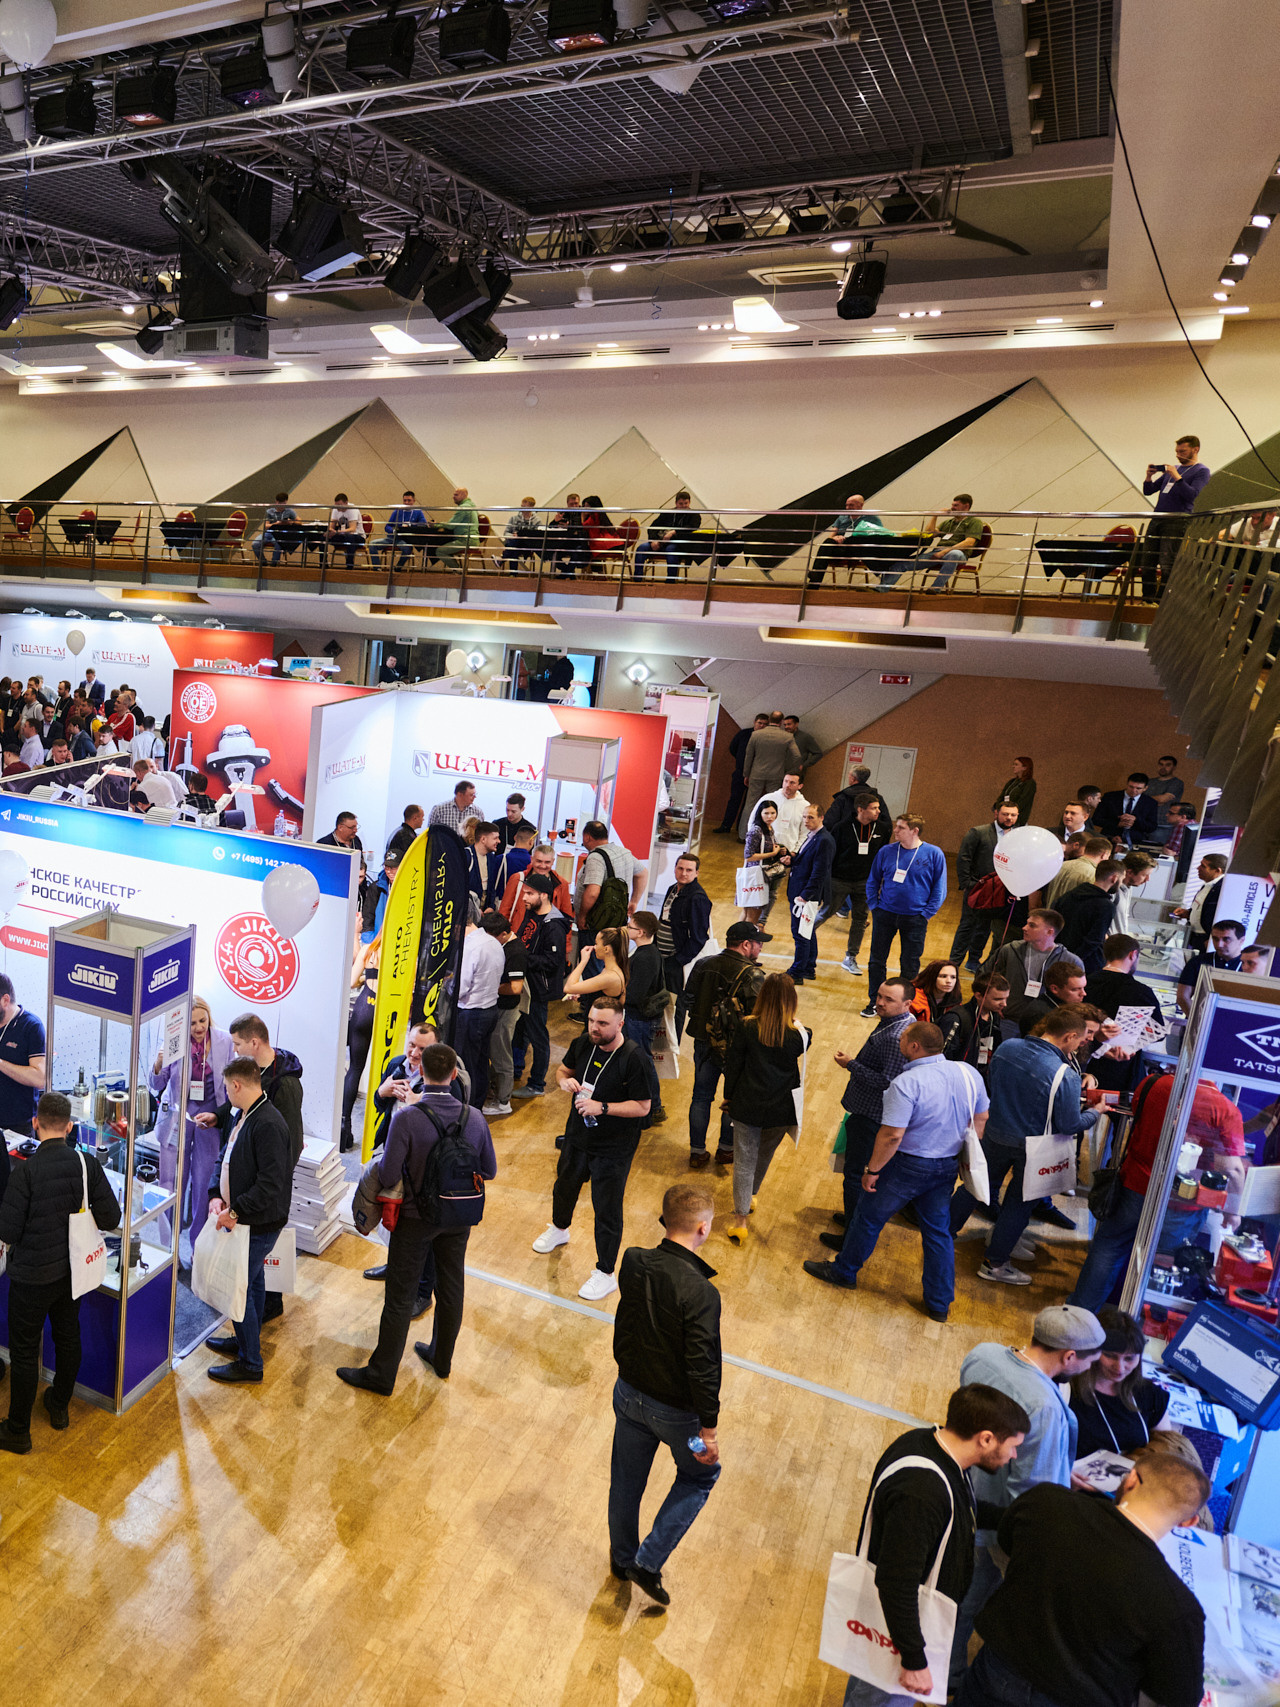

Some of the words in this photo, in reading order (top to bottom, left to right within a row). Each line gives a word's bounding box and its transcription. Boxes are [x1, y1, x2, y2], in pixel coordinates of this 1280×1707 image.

[190, 696, 207, 710] OE
[231, 852, 241, 861] +7
[242, 853, 263, 865] (495)
[264, 858, 279, 868] 142
[31, 884, 120, 914] РОССИЙСКИХ
[75, 876, 142, 899] КАЧЕСТВ
[1241, 881, 1259, 931] 00+ARTICLES
[399, 867, 420, 976] CHEMISTRY
[392, 926, 403, 979] AUTO
[71, 964, 117, 990] JIKIU
[150, 959, 179, 988] JIKIU
[220, 941, 284, 998] サスペンション
